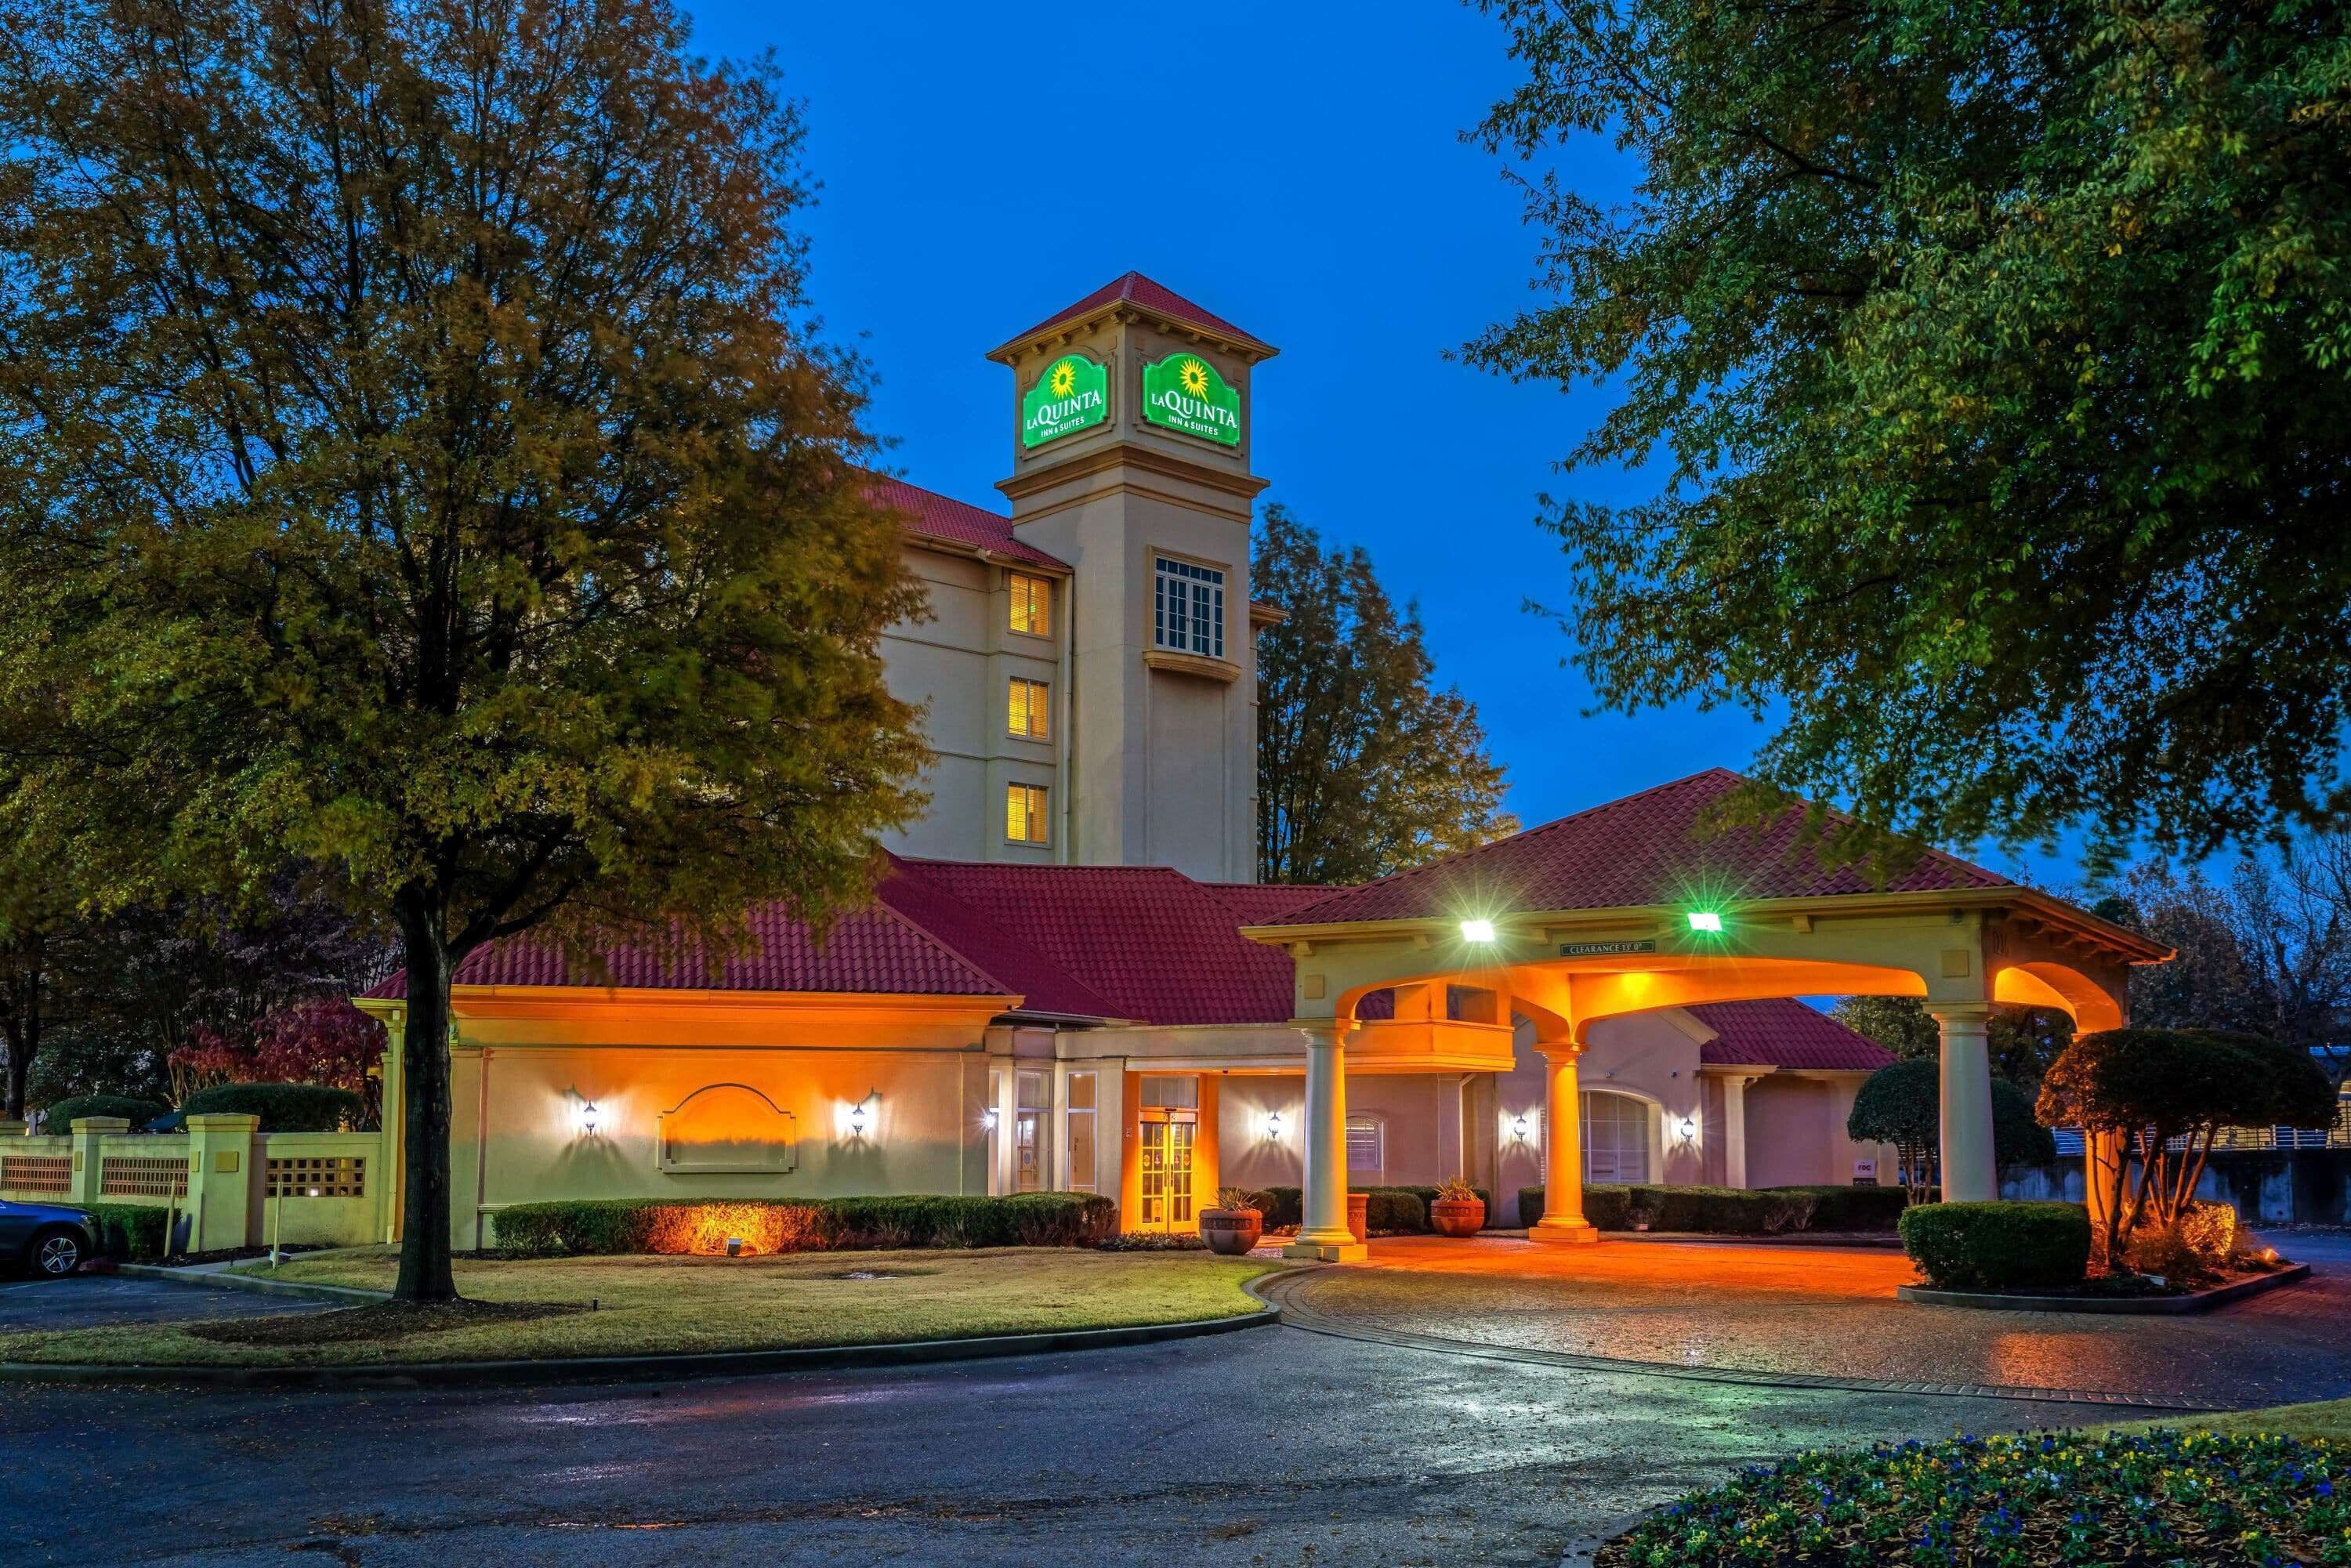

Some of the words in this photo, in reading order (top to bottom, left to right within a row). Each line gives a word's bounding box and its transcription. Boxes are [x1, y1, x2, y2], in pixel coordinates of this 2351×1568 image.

[1027, 418, 1038, 430] LA
[1038, 389, 1102, 425] QUINTA
[1151, 393, 1165, 407] LA
[1165, 390, 1237, 429] QUINTA
[1041, 428, 1053, 438] INN
[1060, 416, 1085, 431] SUITES
[1168, 415, 1183, 425] INN
[1190, 422, 1218, 436] SUITES
[1570, 944, 1620, 954] CLEARANCE
